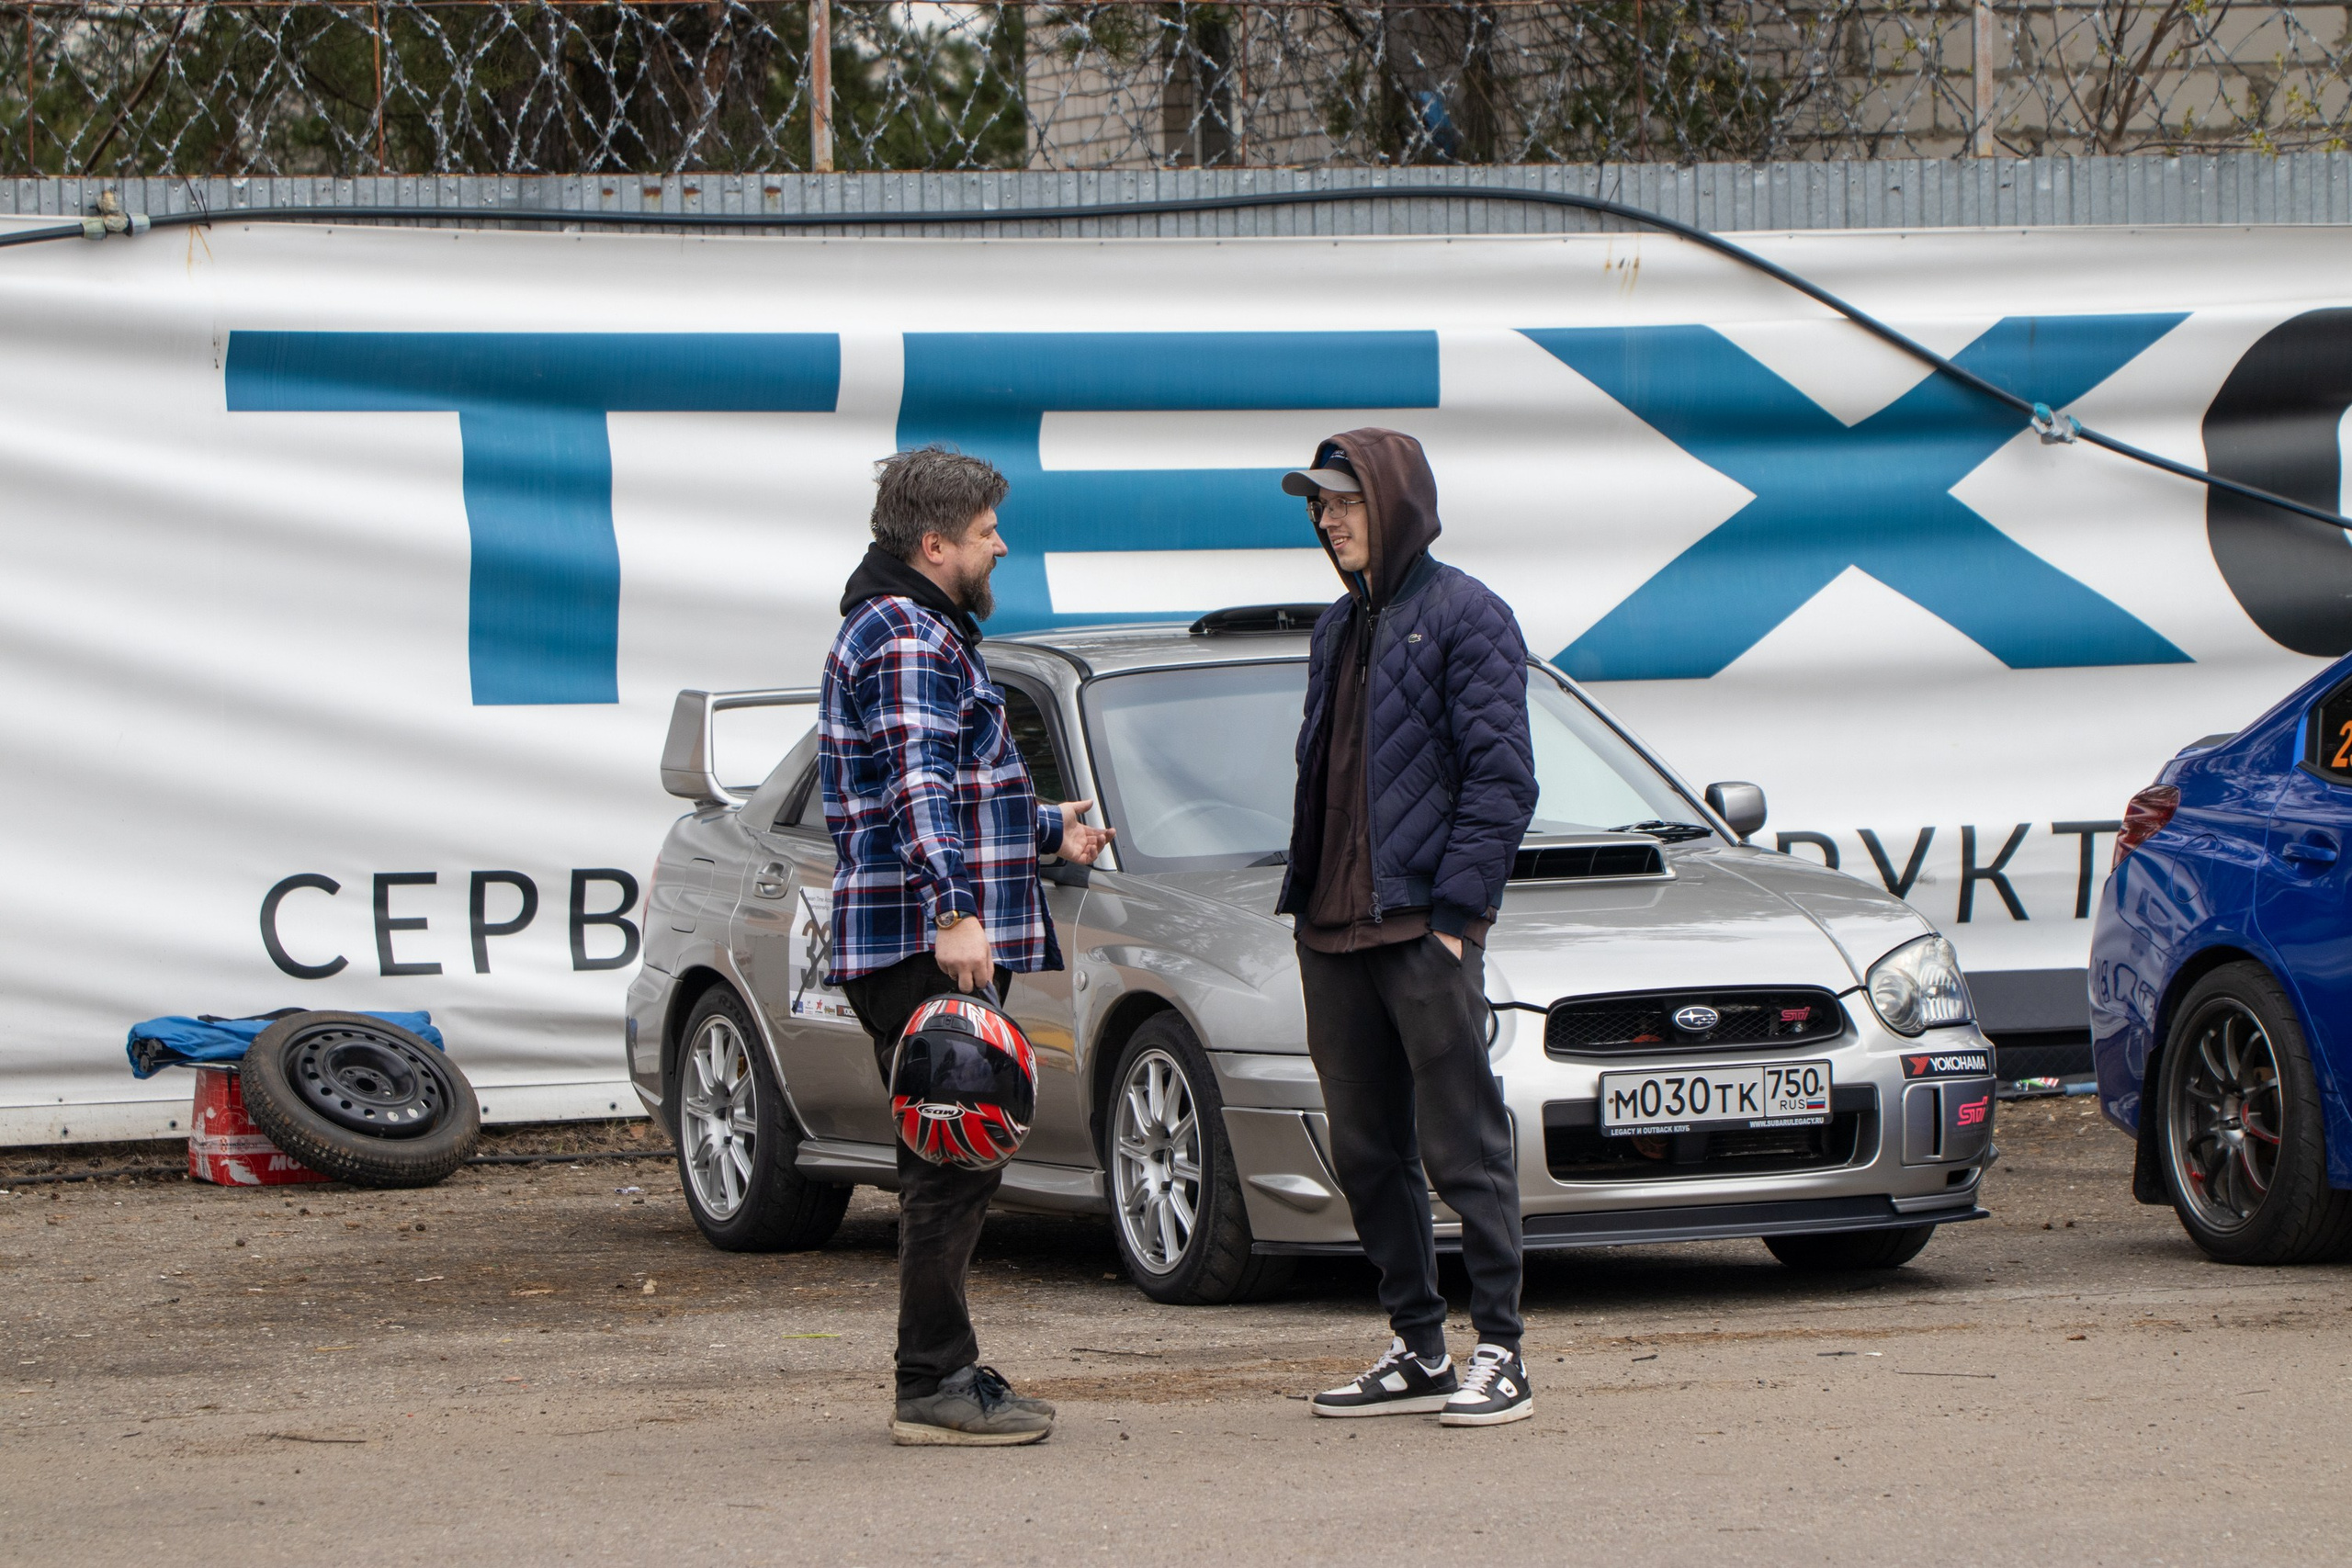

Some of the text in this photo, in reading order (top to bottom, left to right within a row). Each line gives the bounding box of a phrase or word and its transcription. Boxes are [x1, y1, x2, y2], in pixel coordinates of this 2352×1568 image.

[2331, 720, 2352, 767] 2
[260, 868, 639, 980] СЕРВ
[1929, 1055, 1987, 1072] YOKOHAMA
[1767, 1067, 1819, 1100] 750
[1780, 1099, 1805, 1111] RUS
[1611, 1127, 1636, 1136] LEGACY
[1643, 1125, 1673, 1134] OUTBACK
[1673, 1124, 1690, 1133] КЛУБ
[1749, 1116, 1825, 1128] WWW.SUBARULEGACY.RU
[268, 1155, 309, 1171] MO
